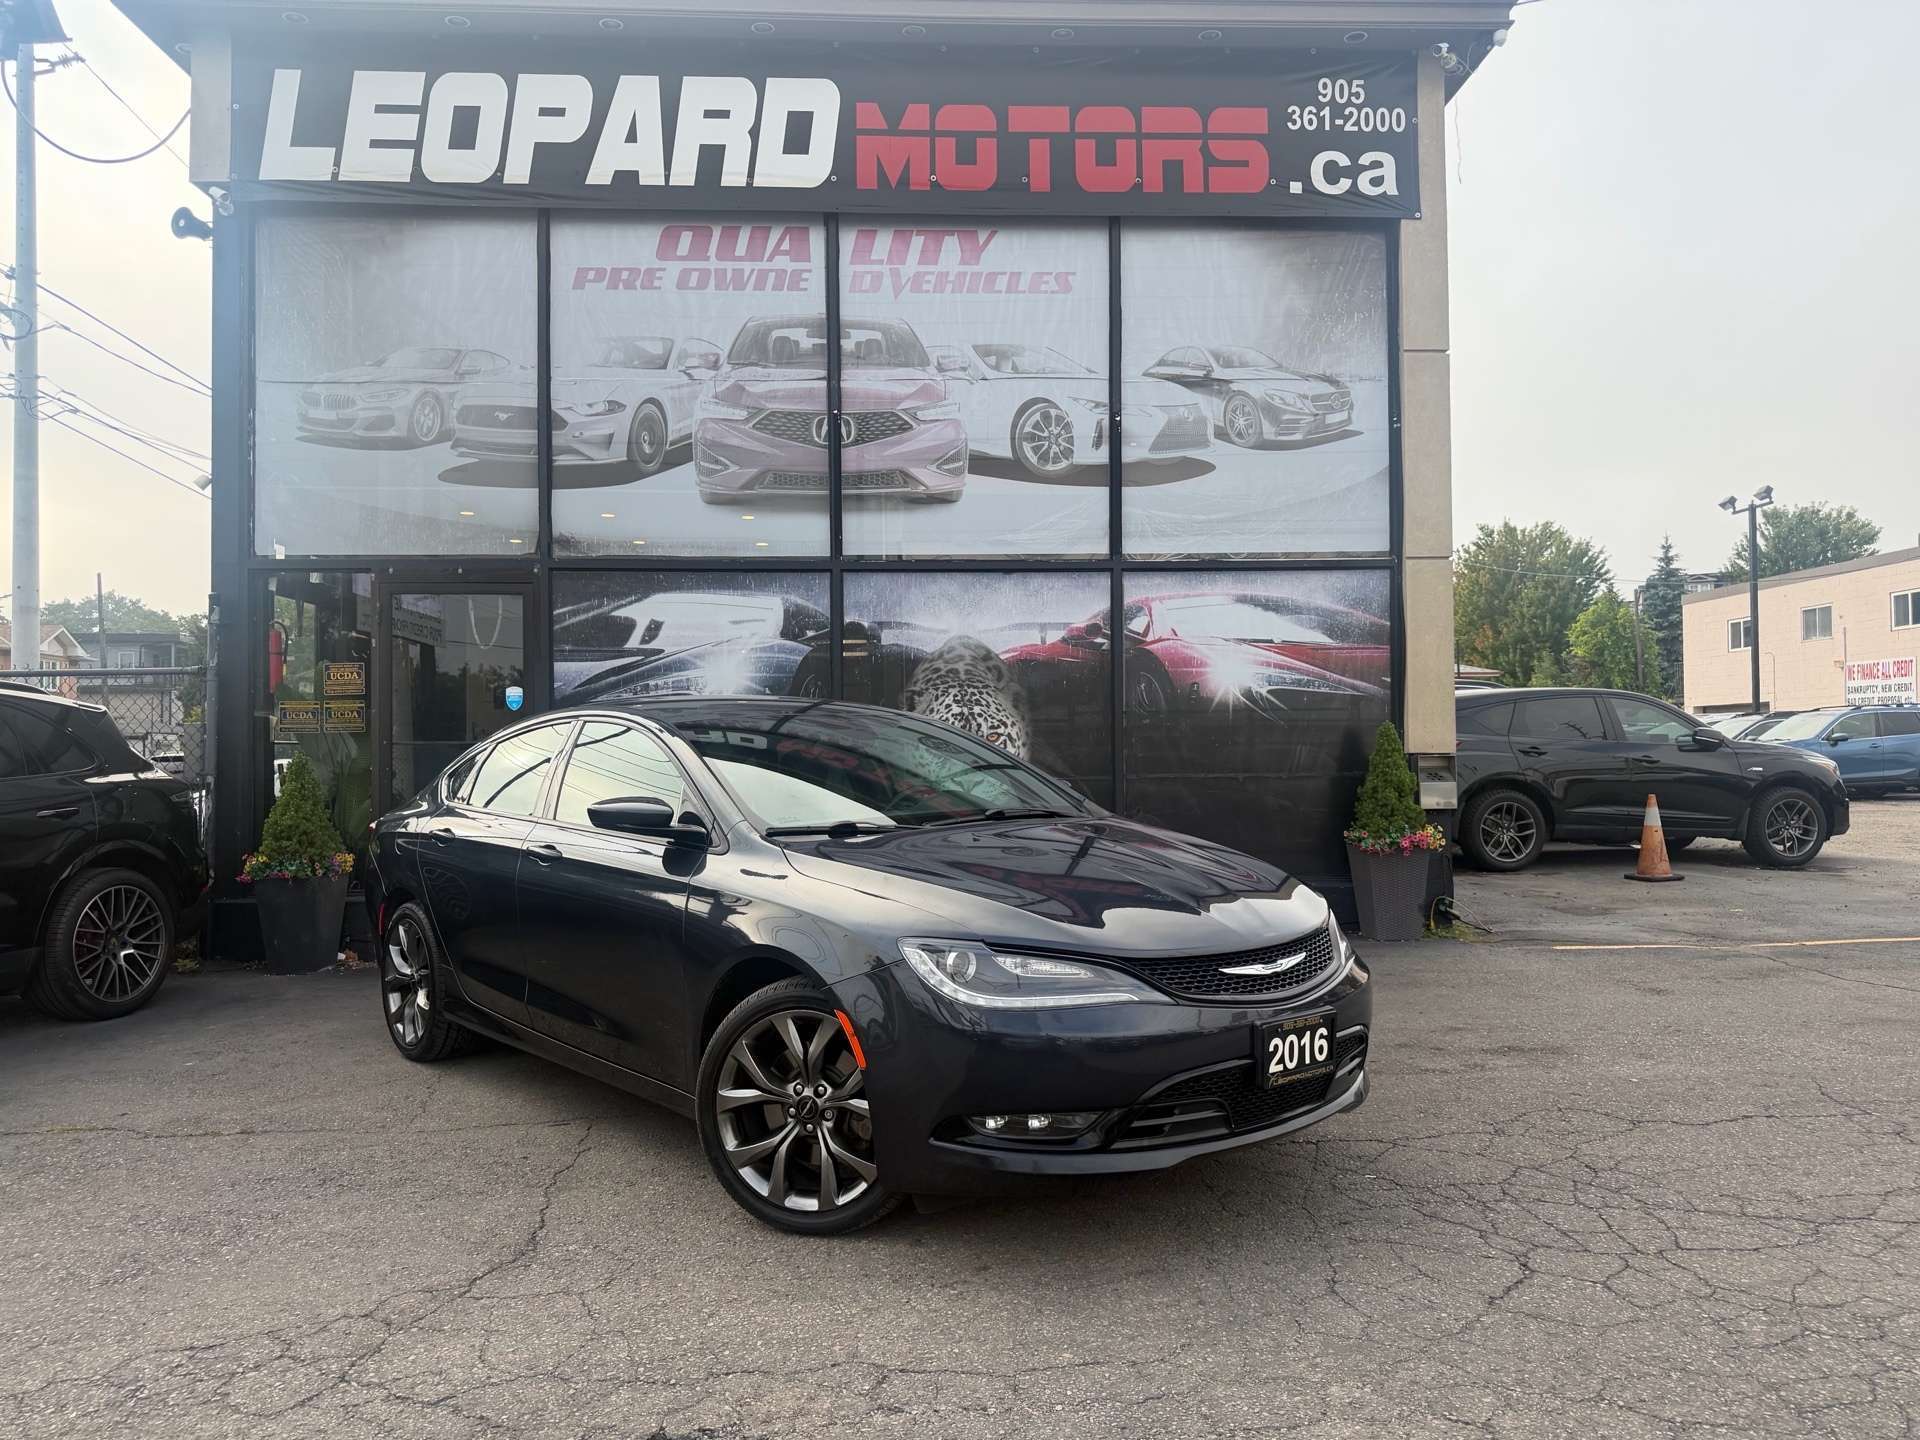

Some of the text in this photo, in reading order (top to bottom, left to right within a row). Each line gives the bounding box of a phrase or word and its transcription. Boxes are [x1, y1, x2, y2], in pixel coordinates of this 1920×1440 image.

[1317, 77, 1366, 104] 905
[258, 68, 1269, 194] LEOPARD MOTORS
[1287, 105, 1406, 132] 361-2000
[1289, 150, 1399, 196] .ca
[571, 267, 667, 291] PRE
[330, 672, 358, 680] UCDA
[1846, 659, 1913, 681] WE FINANCE ALL CREDIT
[1881, 684, 1892, 693] NEW
[286, 711, 313, 719] UCDA
[1268, 1027, 1328, 1074] 2016
